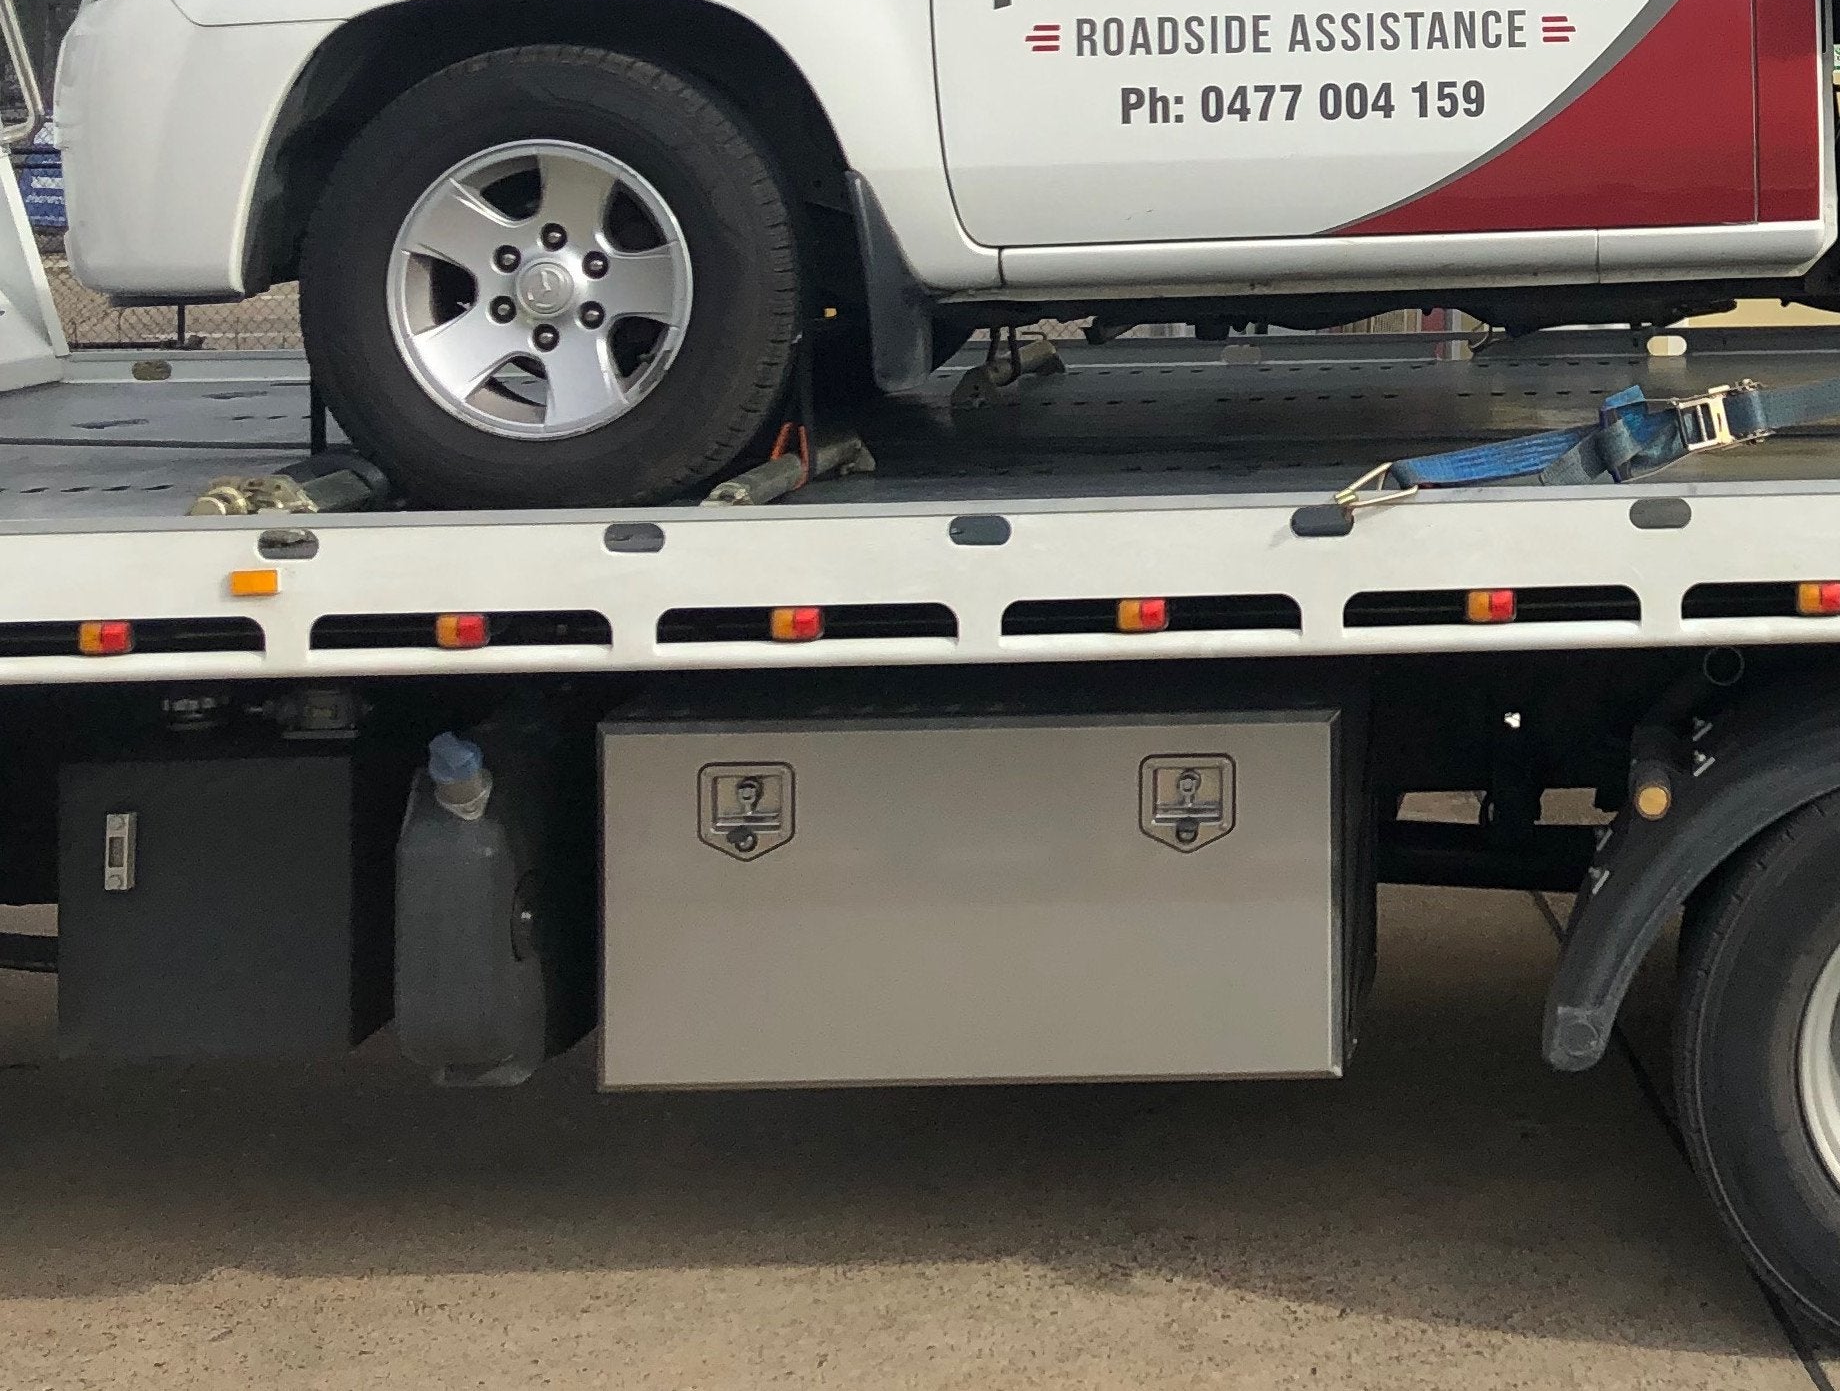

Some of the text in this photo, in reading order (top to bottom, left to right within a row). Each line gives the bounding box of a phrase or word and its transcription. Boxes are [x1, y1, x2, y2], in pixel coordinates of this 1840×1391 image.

[1076, 10, 1526, 56] ROADSIDE ASSISTANCE
[1121, 80, 1484, 124] Ph: 0477 004 159
